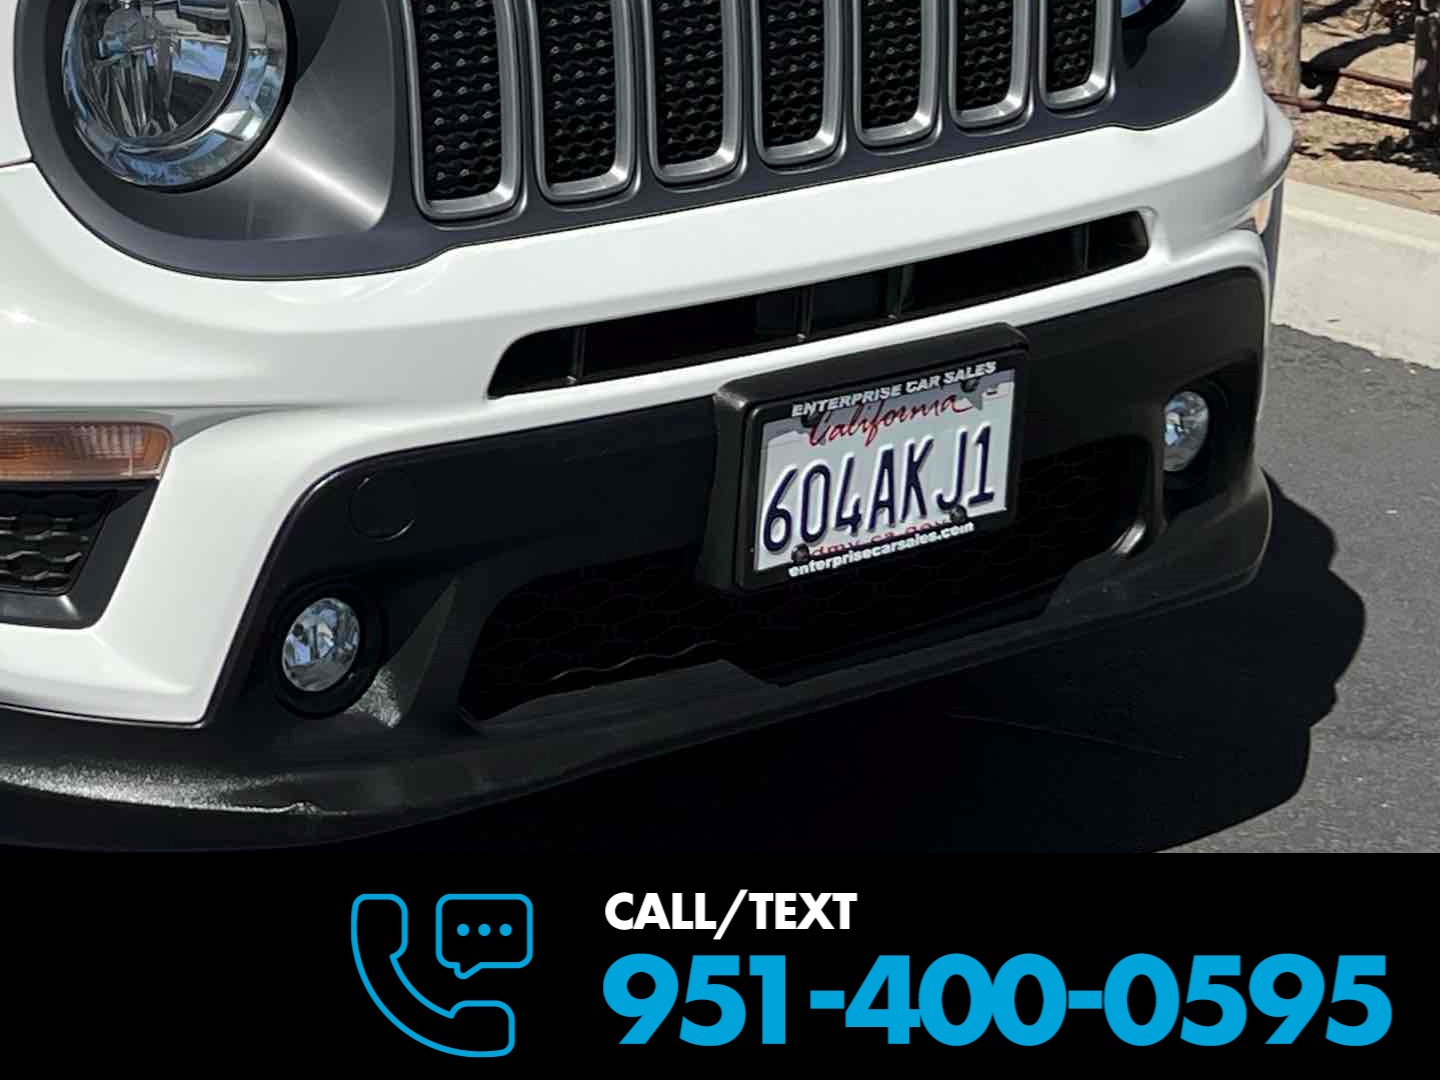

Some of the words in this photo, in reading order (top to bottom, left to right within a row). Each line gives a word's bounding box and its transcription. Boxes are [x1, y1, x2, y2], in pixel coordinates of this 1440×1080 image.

[791, 384, 903, 417] ENTERPRISE
[905, 375, 941, 394] CAR
[943, 361, 997, 385] SALES
[762, 424, 994, 553] 604AKJ1
[788, 521, 975, 577] enterprisecarsales.com
